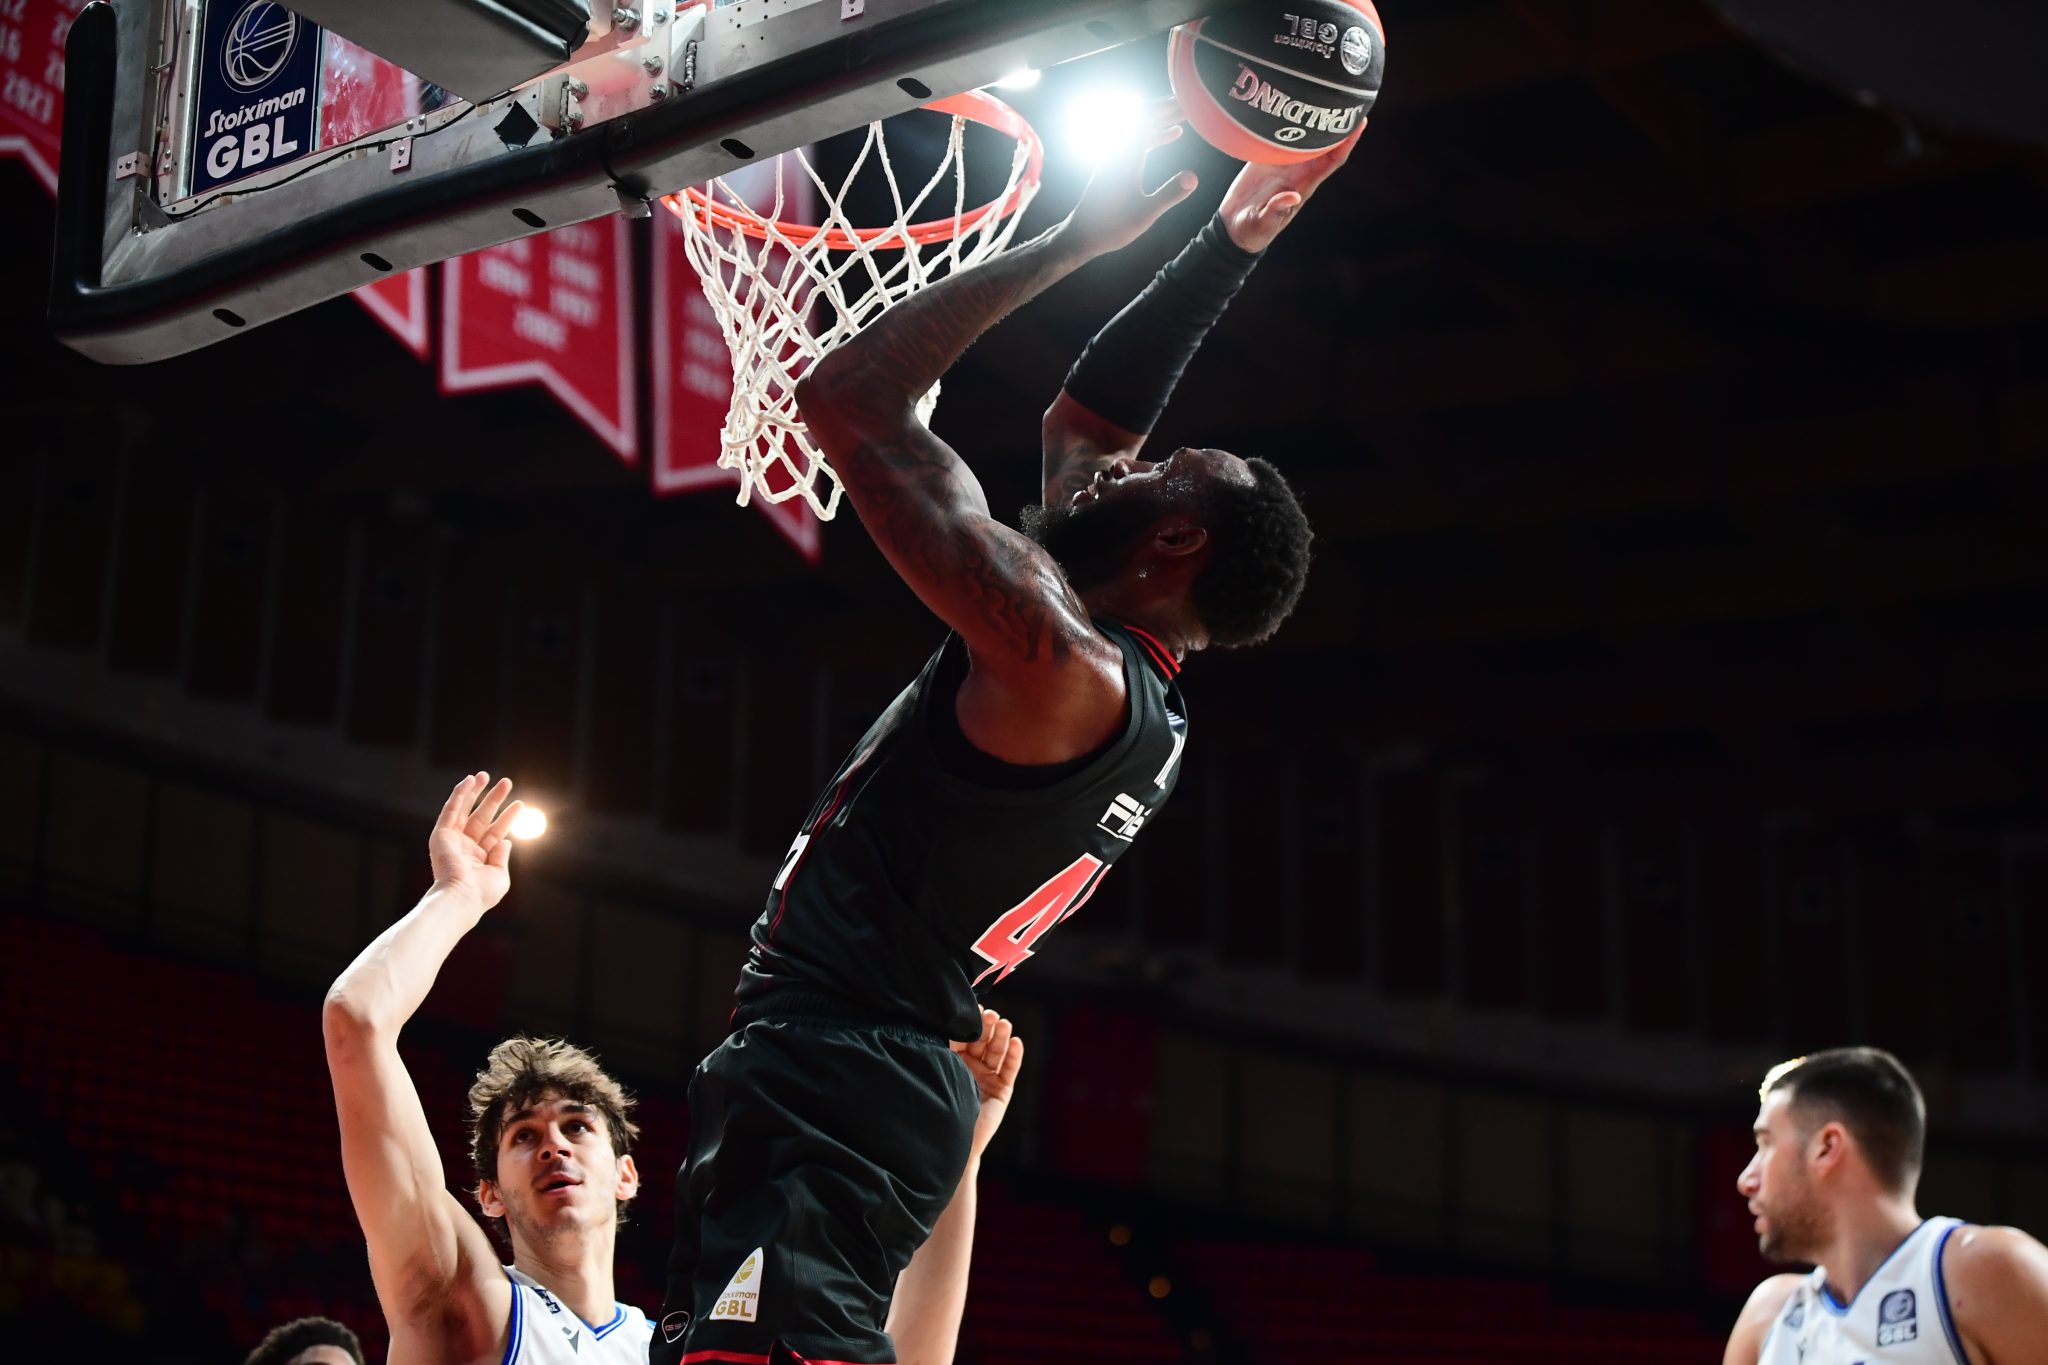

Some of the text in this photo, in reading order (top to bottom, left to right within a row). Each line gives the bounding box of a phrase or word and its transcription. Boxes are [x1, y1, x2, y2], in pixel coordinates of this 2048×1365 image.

[1274, 34, 1336, 59] Stoiximan
[1283, 13, 1339, 44] GBL
[204, 87, 306, 138] Stoiximan
[1228, 64, 1364, 134] SPALDING
[206, 115, 298, 179] GBL
[715, 1299, 752, 1318] GBL
